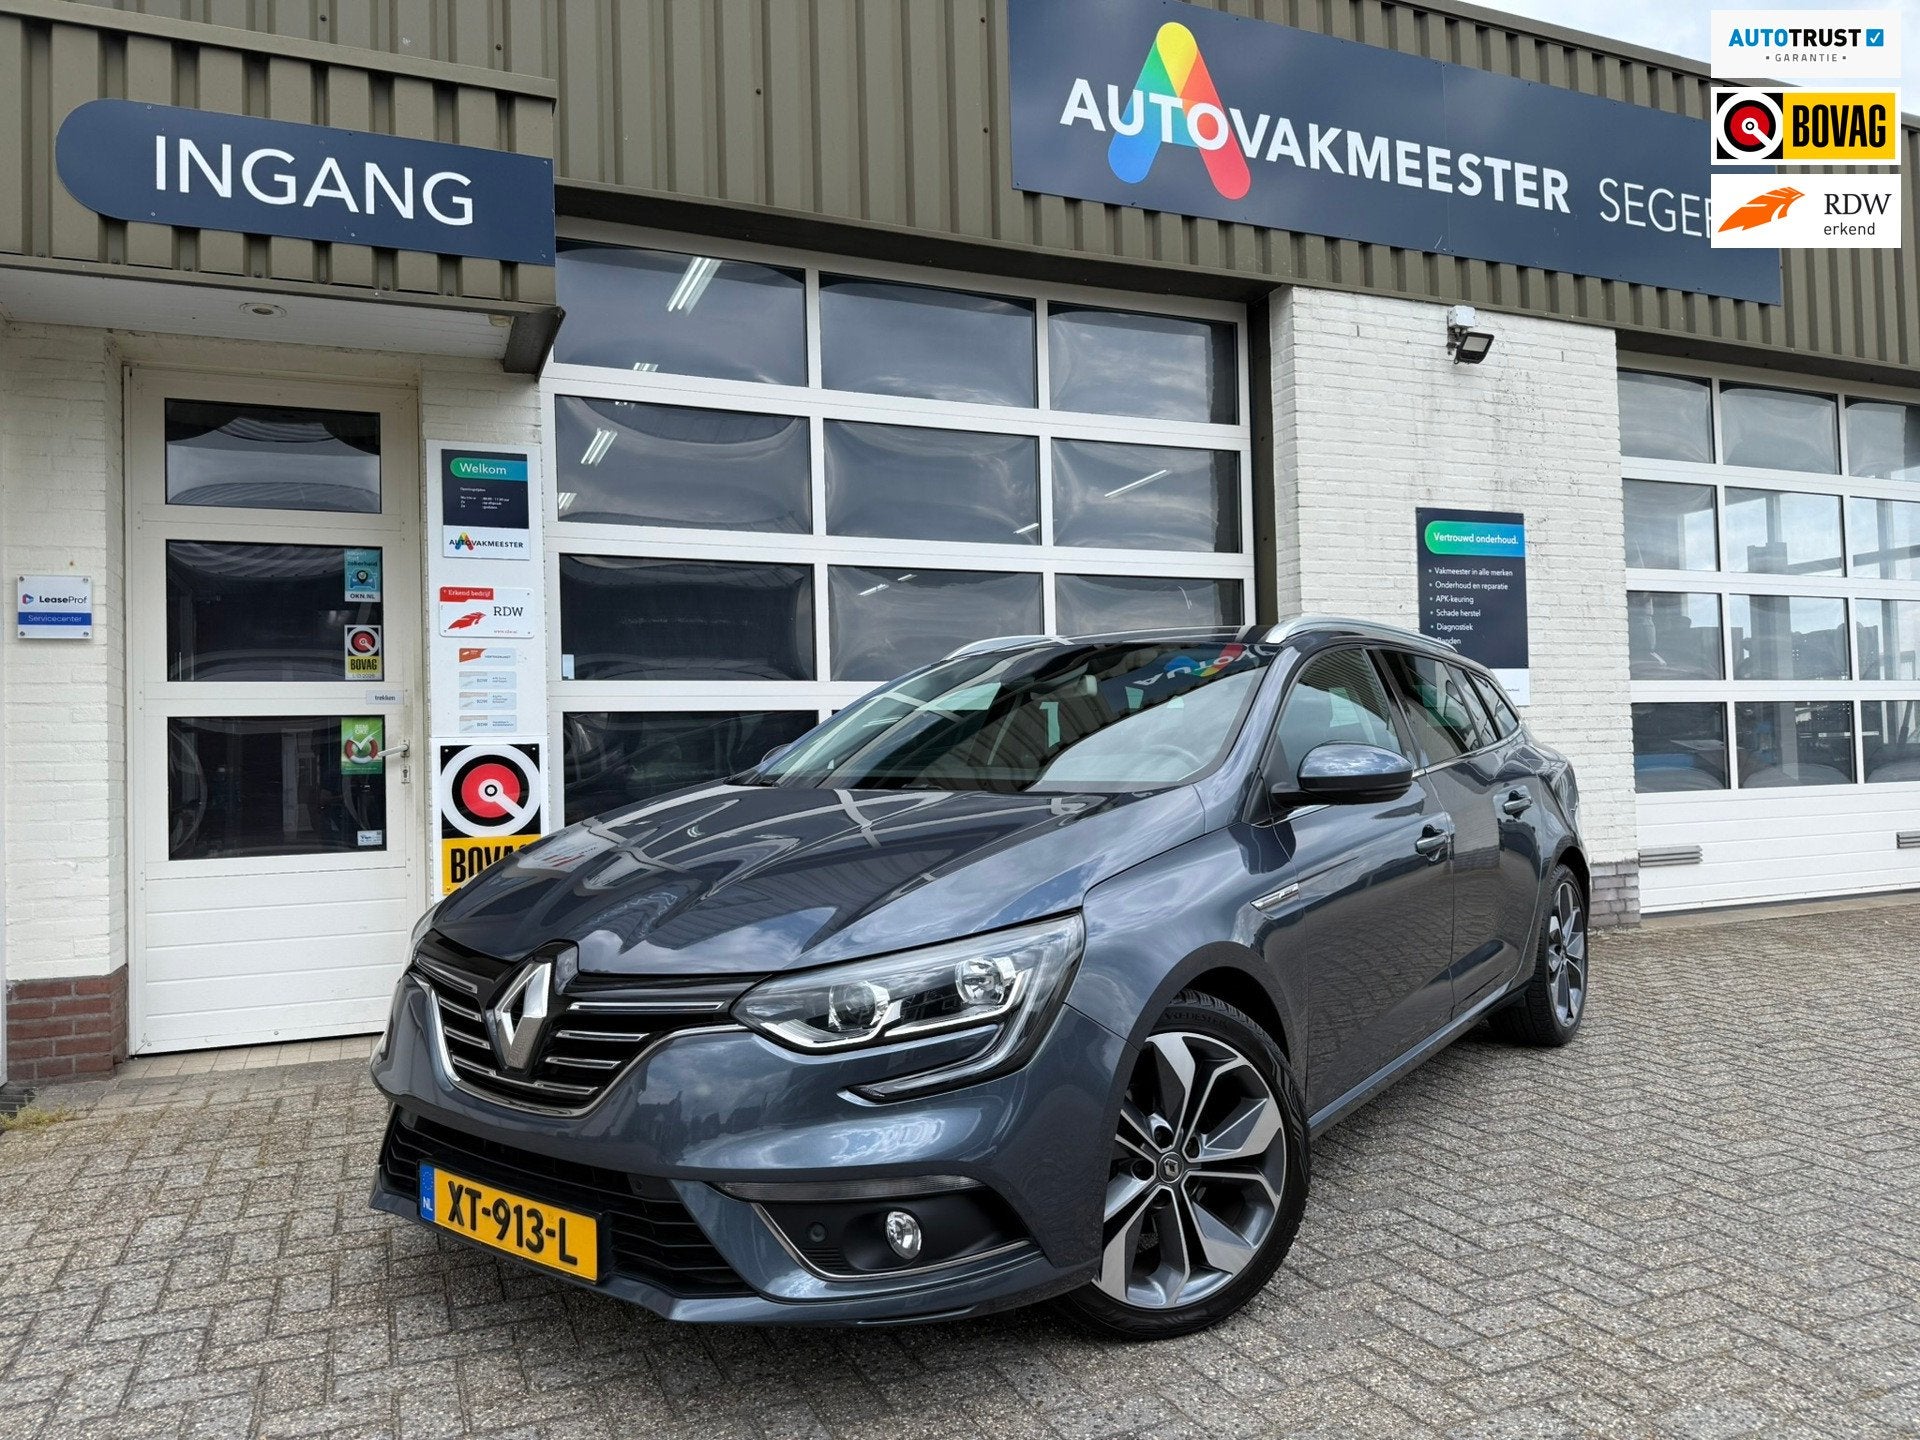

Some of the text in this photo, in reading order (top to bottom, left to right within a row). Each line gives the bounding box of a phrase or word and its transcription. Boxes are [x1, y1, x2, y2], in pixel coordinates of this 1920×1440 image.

[1060, 78, 1711, 239] AUTOVAKMEESTER SEGE
[155, 135, 473, 226] INGANG
[460, 463, 507, 475] Welkom
[449, 539, 524, 548] AUTOVAKMEESTER
[1433, 532, 1519, 544] Vertrouwd onderhoud.
[1434, 567, 1471, 575] Vakmeester
[1479, 568, 1490, 576] alle
[1490, 569, 1513, 577] merken
[1435, 581, 1471, 589] Onderhoud
[1481, 582, 1508, 591] reparatie
[39, 596, 87, 604] LeaseProf
[1435, 595, 1474, 605] APK-keuring
[494, 606, 524, 617] RDW
[1460, 609, 1481, 617] herstel
[28, 614, 82, 623] Servicecenter
[1436, 623, 1473, 632] Diagnostiek
[350, 659, 377, 670] BOVAG
[451, 844, 526, 883] BOV
[423, 1197, 433, 1211] NL
[448, 1180, 578, 1266] XT-913-L
